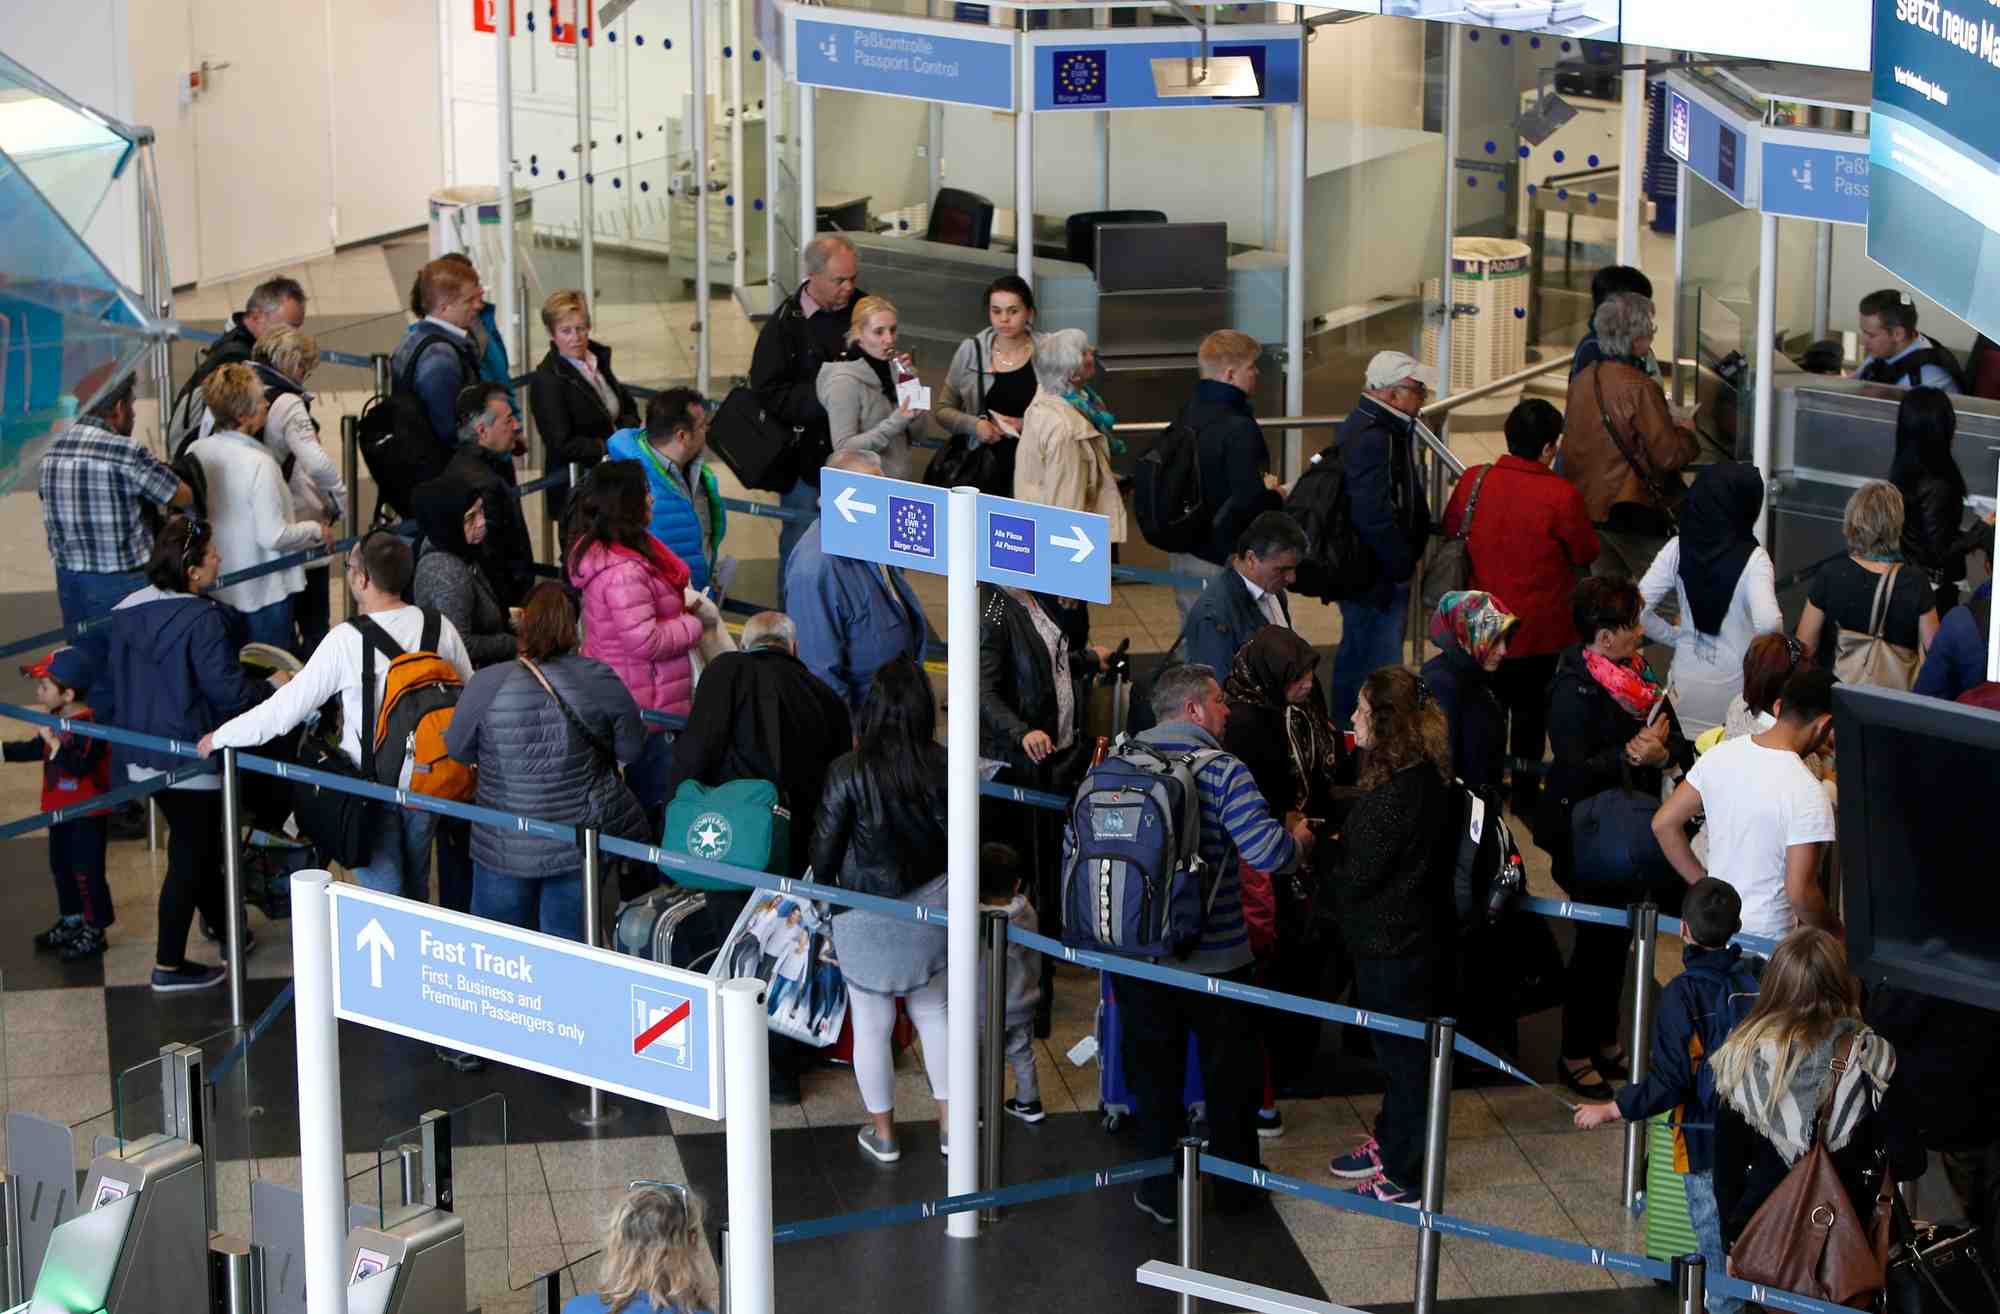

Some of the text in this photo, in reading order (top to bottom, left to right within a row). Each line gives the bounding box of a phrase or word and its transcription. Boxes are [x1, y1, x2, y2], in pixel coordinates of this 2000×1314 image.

[854, 30, 934, 54] Paßkontrolle
[1896, 0, 1940, 35] setzt
[1942, 9, 1978, 54] neue
[854, 50, 959, 78] Passport Control
[419, 929, 534, 984] Fast Track
[422, 964, 543, 1011] First, Business and
[422, 984, 585, 1047] Premium Passengers only
